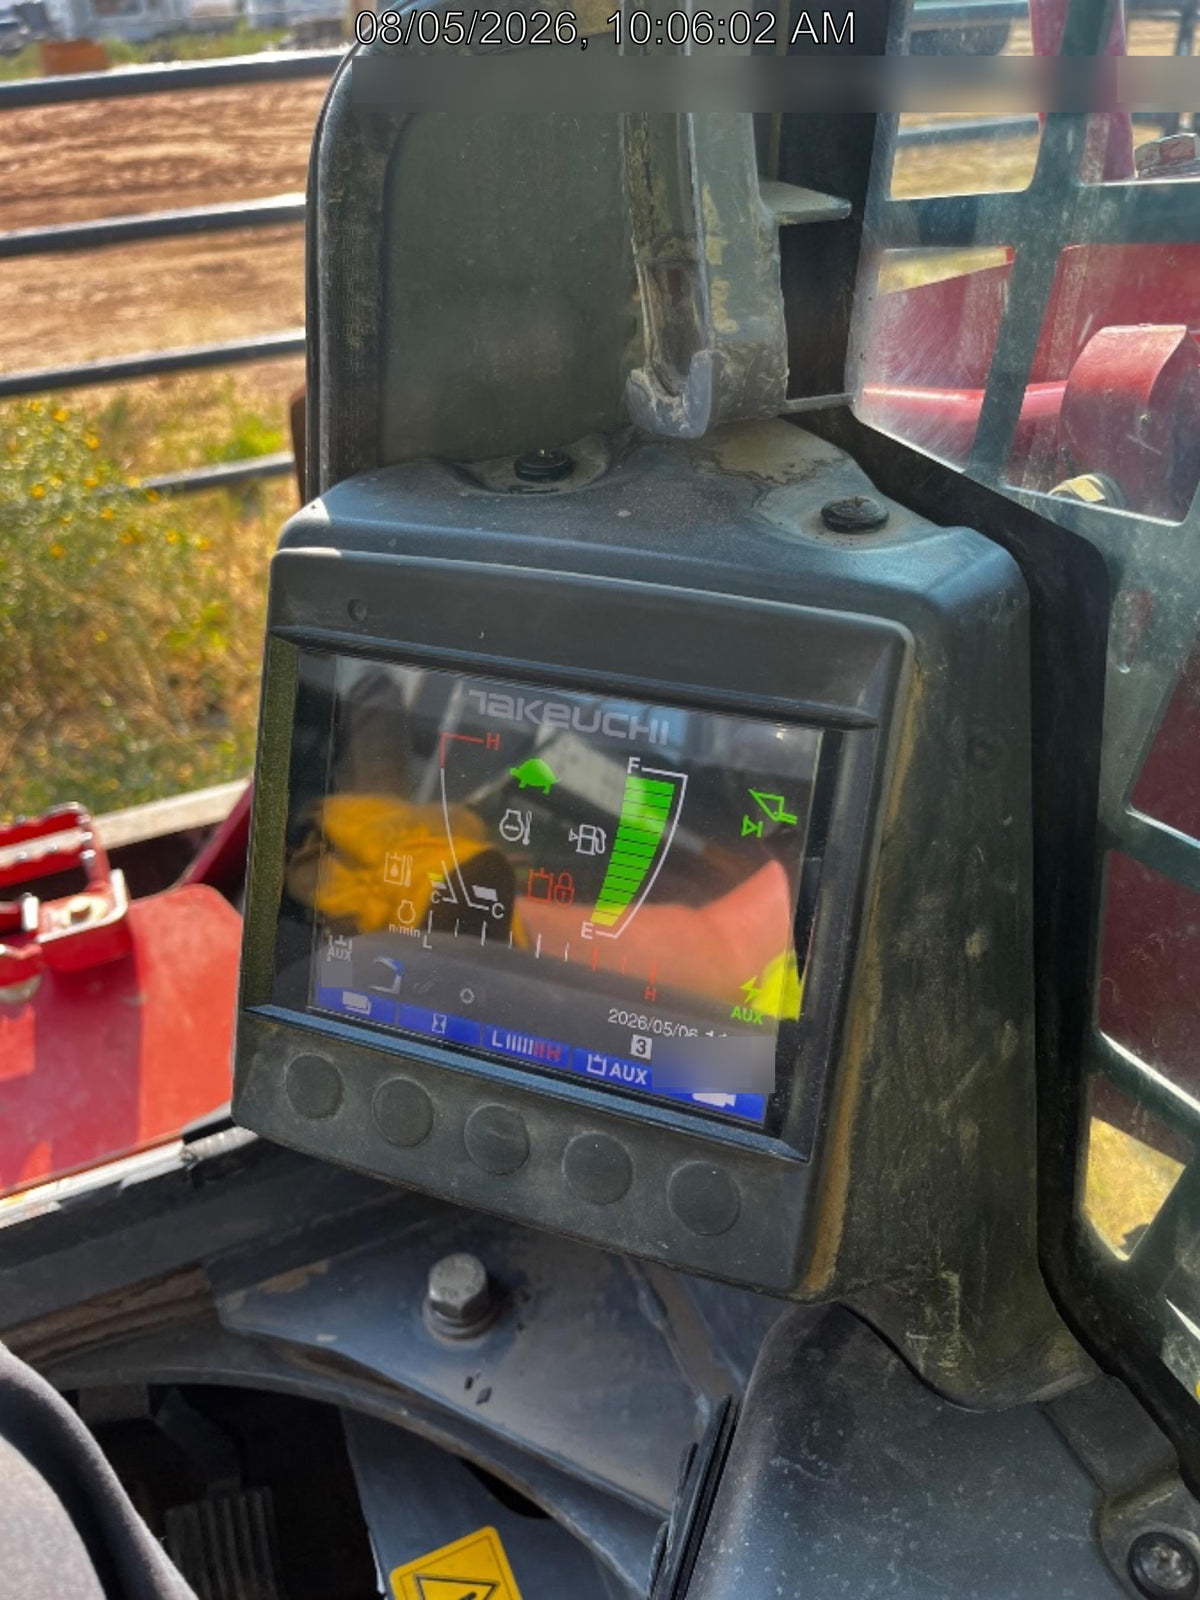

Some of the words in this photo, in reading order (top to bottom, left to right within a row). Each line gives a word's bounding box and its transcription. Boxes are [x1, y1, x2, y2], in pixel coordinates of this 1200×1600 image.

[486, 731, 499, 751] H
[627, 756, 640, 774] F
[491, 902, 505, 919] C
[581, 920, 594, 940] E
[730, 1005, 763, 1025] AUX
[635, 1038, 647, 1055] 3
[609, 1062, 649, 1086] AUX
